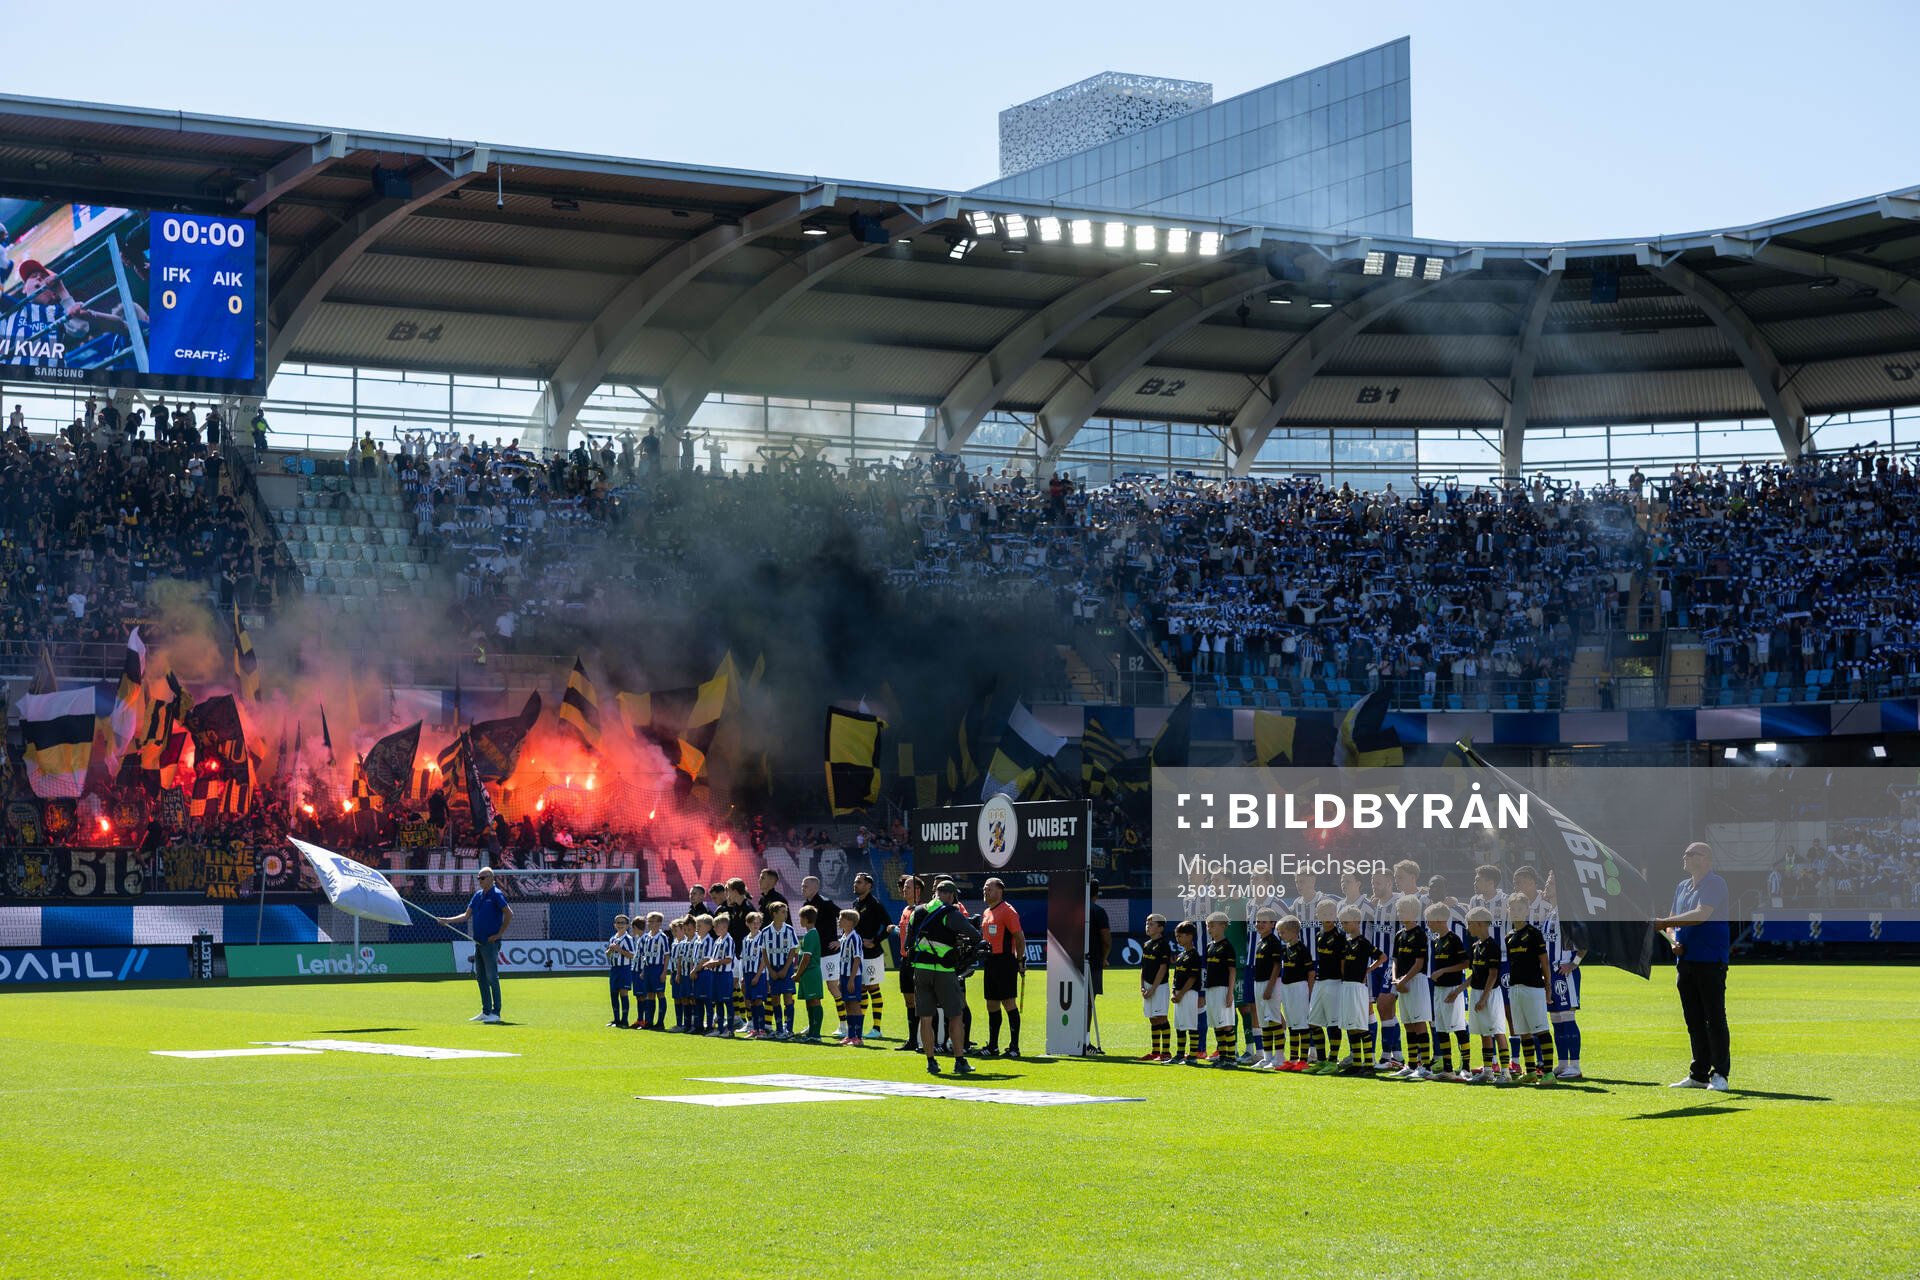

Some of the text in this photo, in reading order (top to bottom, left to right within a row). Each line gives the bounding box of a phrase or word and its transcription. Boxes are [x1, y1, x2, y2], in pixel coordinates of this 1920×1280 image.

[163, 219, 245, 248] 00:00
[163, 267, 243, 287] IFK AIK
[162, 290, 242, 315] 0 0
[15, 340, 65, 359] KVAR
[175, 349, 218, 362] CRAFT
[35, 366, 84, 379] SAMSUNG
[1135, 377, 1186, 397] B2
[1356, 385, 1400, 404] B1
[1128, 655, 1145, 671] B2
[921, 821, 968, 842] UNIBET
[1028, 817, 1078, 838] UNIBET
[206, 883, 239, 899] AIK
[201, 941, 212, 980] SELECT
[297, 953, 389, 974] Lendo.se
[1060, 981, 1073, 1011] U
